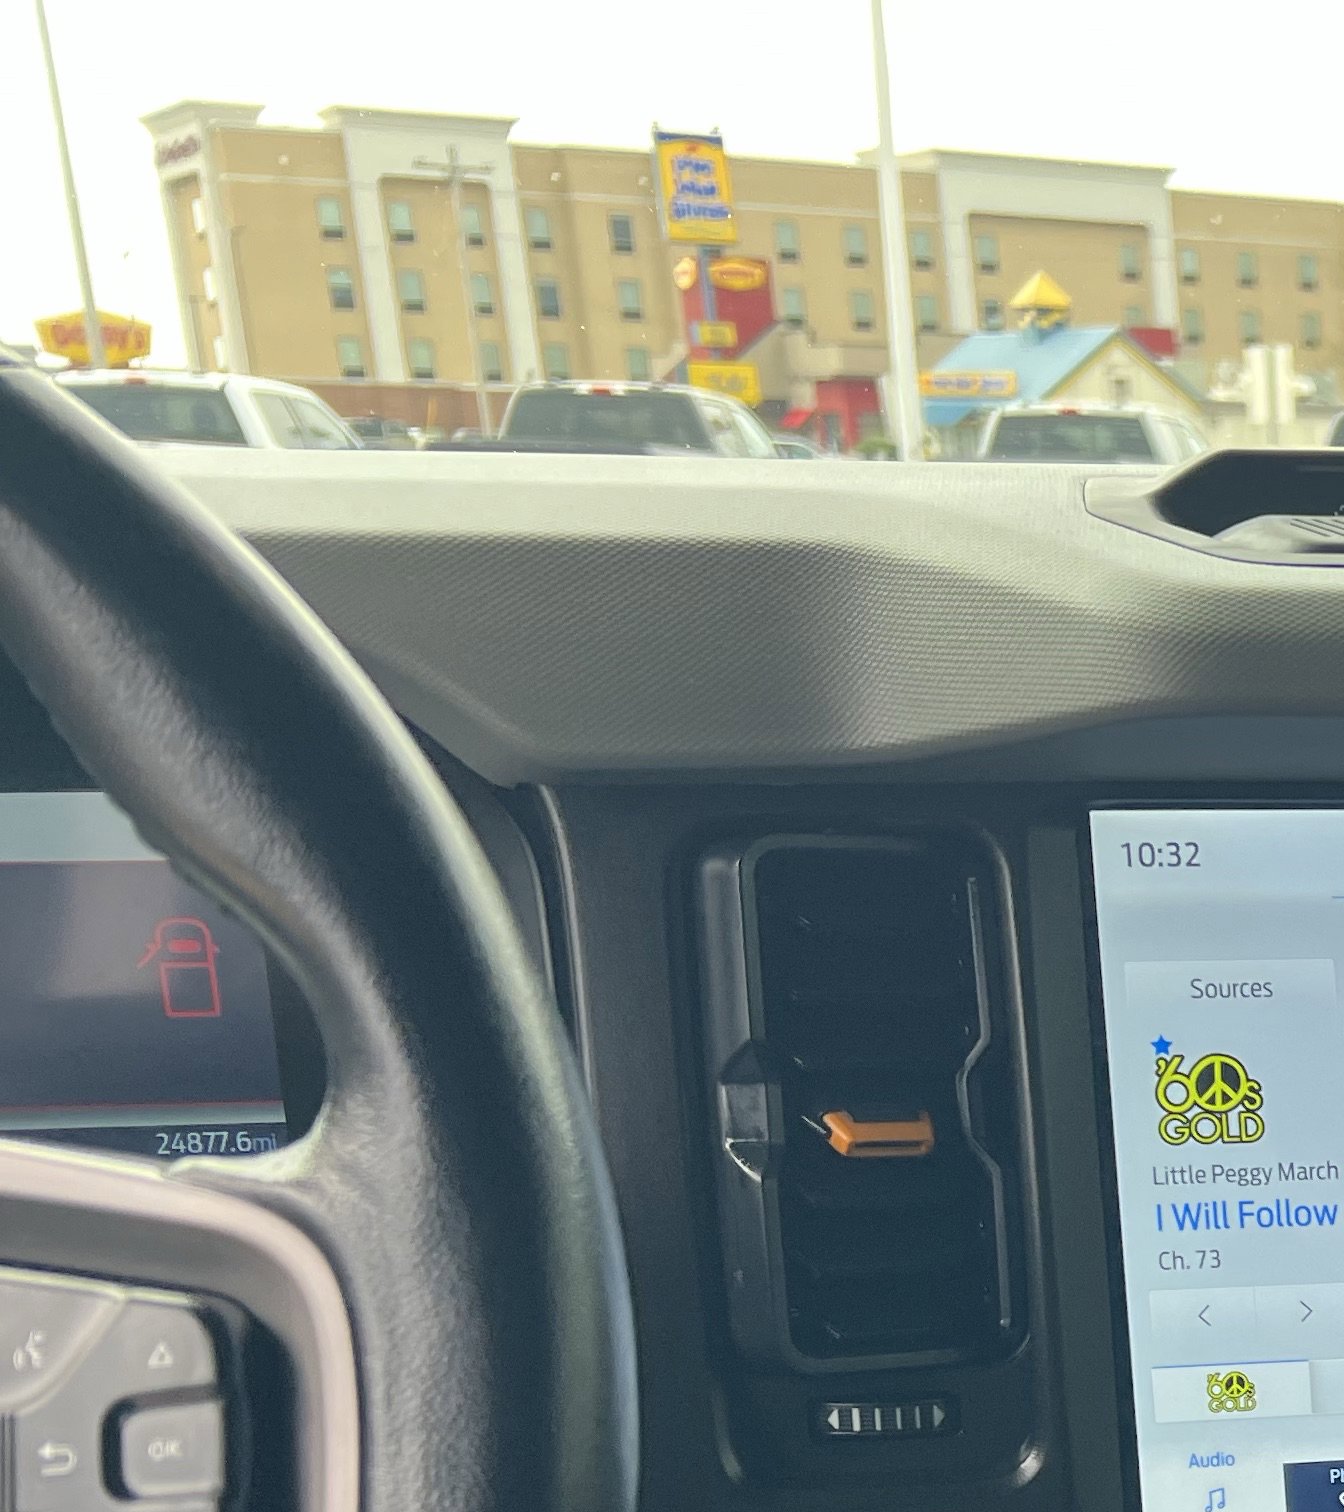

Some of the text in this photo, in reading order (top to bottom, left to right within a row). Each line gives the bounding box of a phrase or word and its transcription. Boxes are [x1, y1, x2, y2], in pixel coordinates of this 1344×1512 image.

[1121, 842, 1201, 868] 10:32
[1190, 978, 1273, 999] Sources
[1158, 1111, 1265, 1146] GOLD
[1152, 1160, 1339, 1187] Little Peggy March
[1156, 1204, 1164, 1231] I
[1172, 1201, 1231, 1231] Will
[1238, 1198, 1339, 1229] Follow
[1158, 1249, 1222, 1271] Ch. 73
[1208, 1397, 1257, 1413] GOLD
[148, 1439, 182, 1458] OK
[1188, 1450, 1235, 1469] Audio
